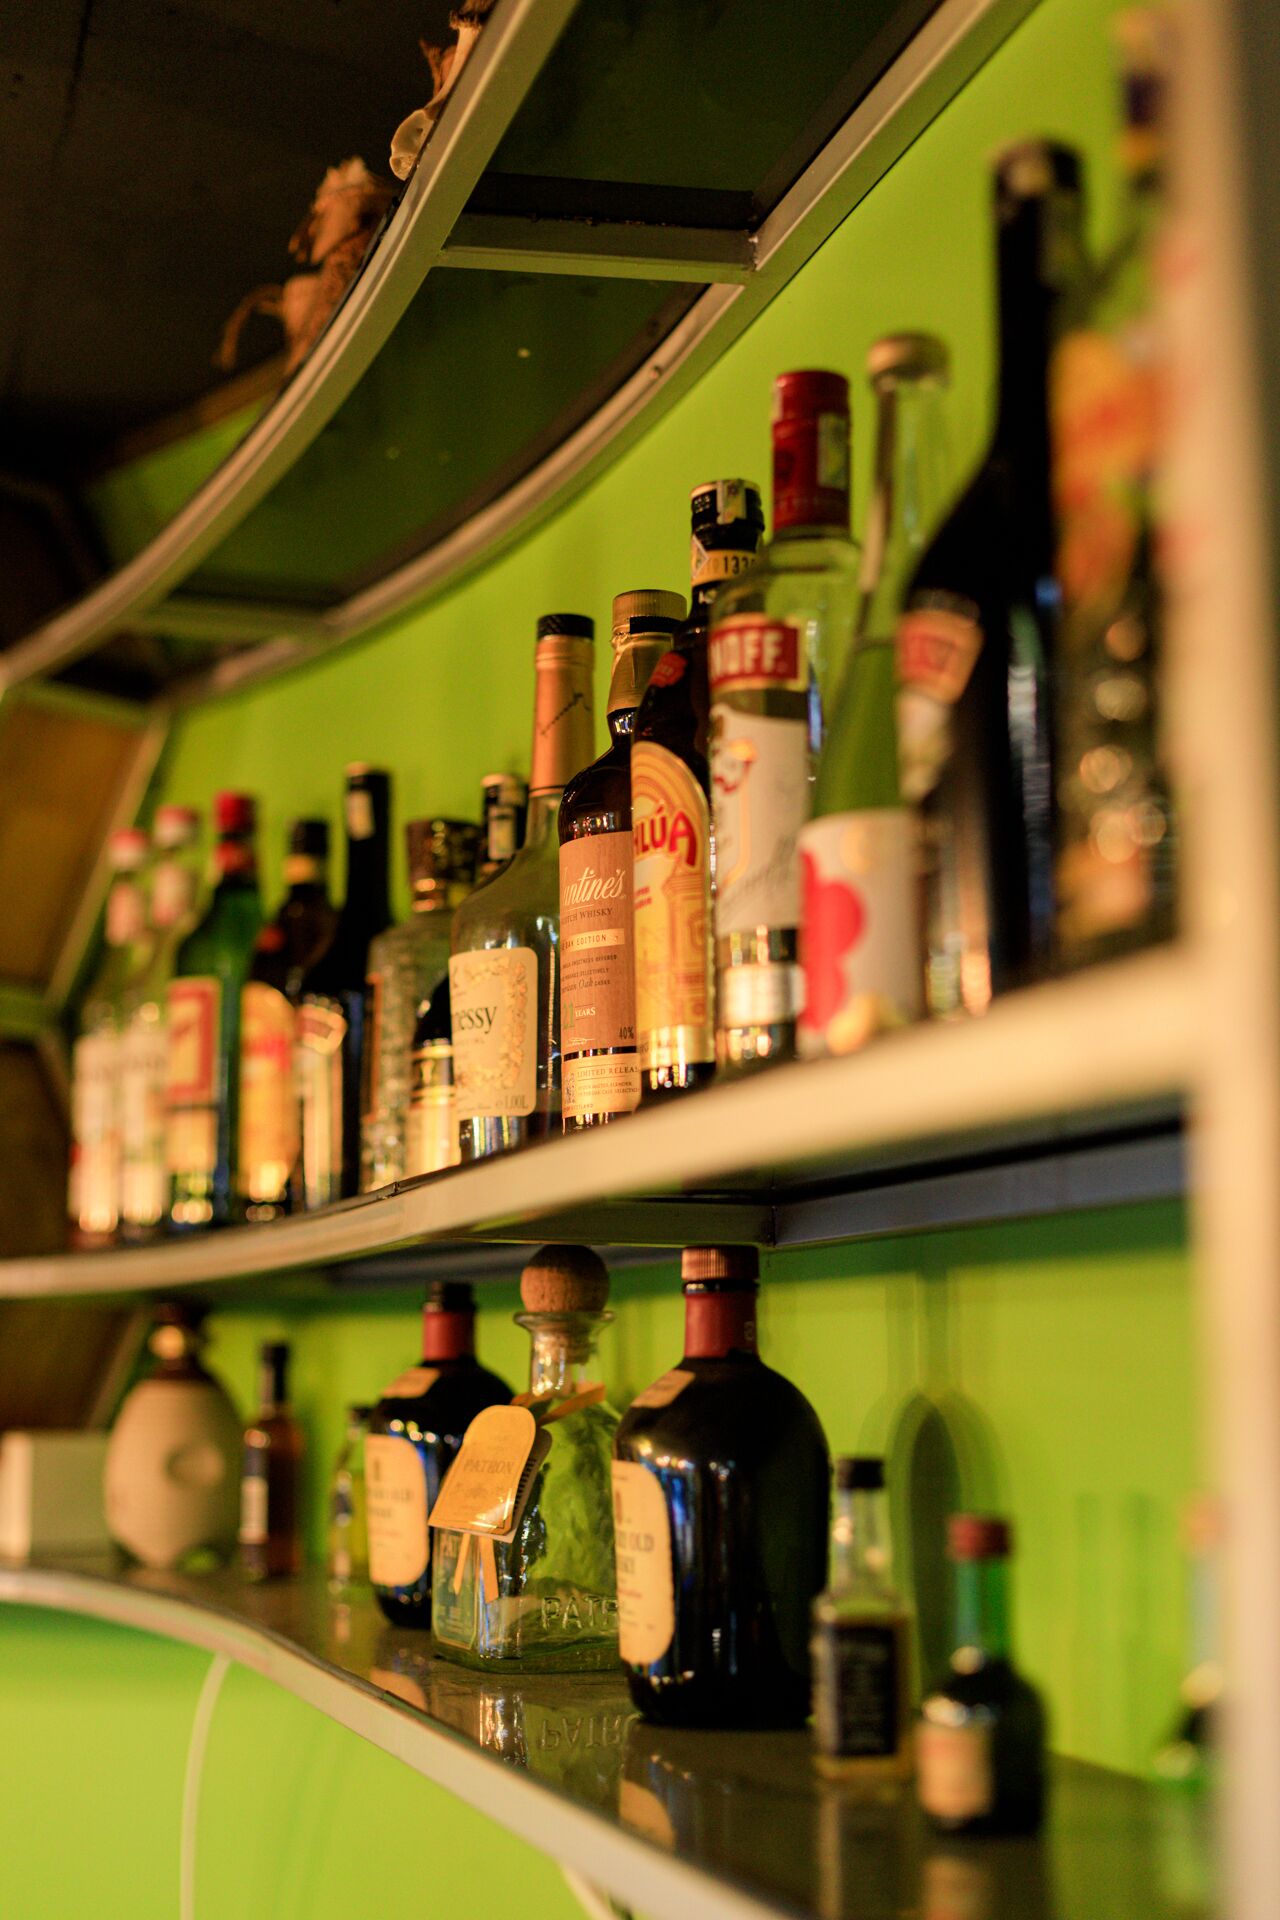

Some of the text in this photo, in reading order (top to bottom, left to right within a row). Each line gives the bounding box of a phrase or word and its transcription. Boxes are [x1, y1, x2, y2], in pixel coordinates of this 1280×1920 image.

[579, 907, 613, 919] WHISKY
[576, 934, 607, 946] EDITION
[575, 1006, 596, 1017] YEARS
[618, 1026, 635, 1040] 40%
[577, 1068, 606, 1078] LIMITED
